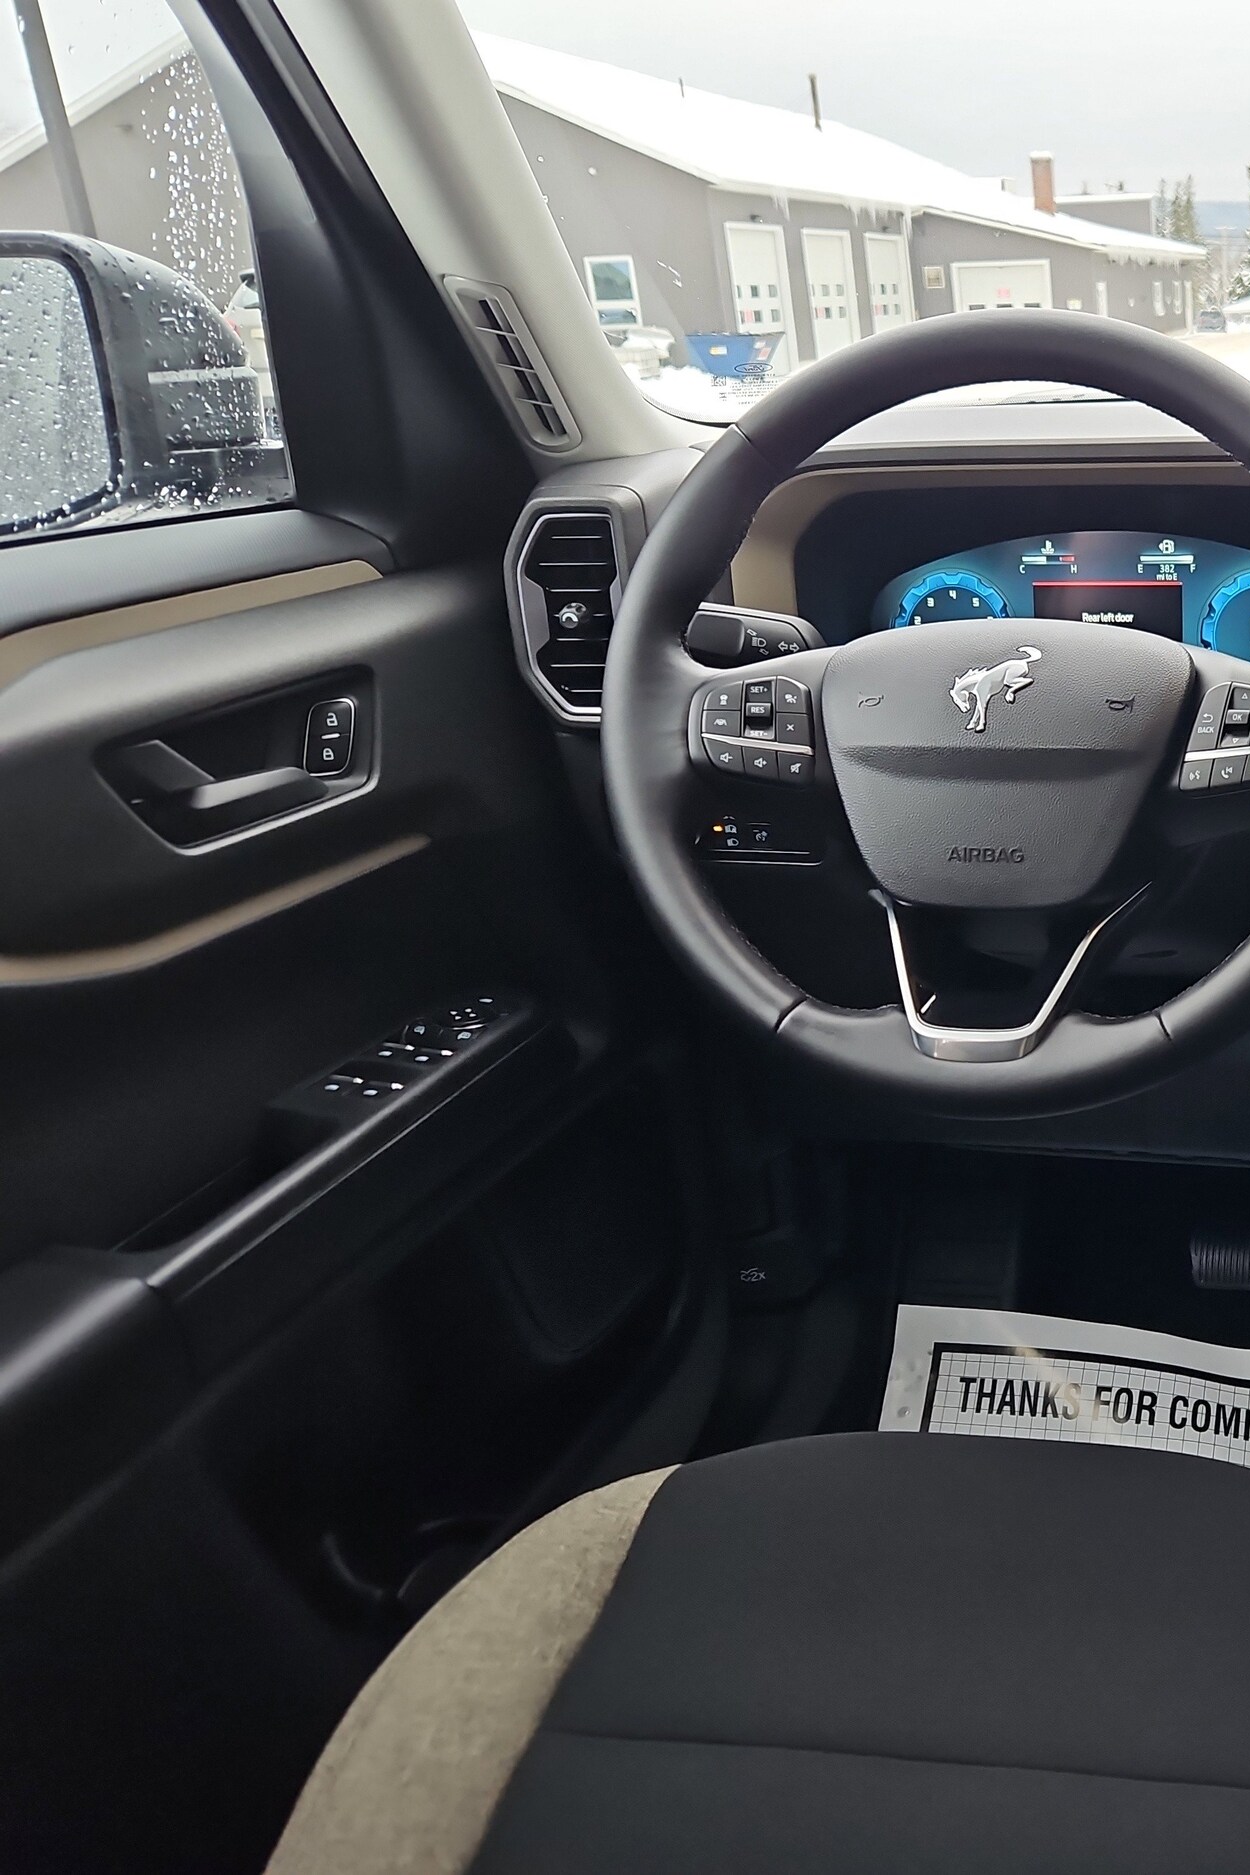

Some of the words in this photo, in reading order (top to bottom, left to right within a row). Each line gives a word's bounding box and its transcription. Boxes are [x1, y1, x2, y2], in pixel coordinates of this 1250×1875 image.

[1019, 564, 1026, 574] C
[1070, 565, 1078, 574] H
[1137, 564, 1144, 574] E
[1159, 564, 1175, 573] 382
[1189, 564, 1196, 574] F
[1156, 573, 1166, 581] mi
[1165, 573, 1173, 581] to
[948, 590, 957, 599] 4
[926, 597, 935, 607] 3
[972, 597, 980, 607] 5
[1082, 612, 1101, 623] Rear
[1101, 612, 1114, 623] left
[1114, 612, 1135, 623] door
[750, 706, 765, 714] RES
[1232, 713, 1242, 721] OK
[1197, 726, 1215, 734] BACK
[947, 845, 1025, 864] AIRBAG
[958, 1377, 1082, 1422] THANKS
[1093, 1385, 1157, 1426] FOR
